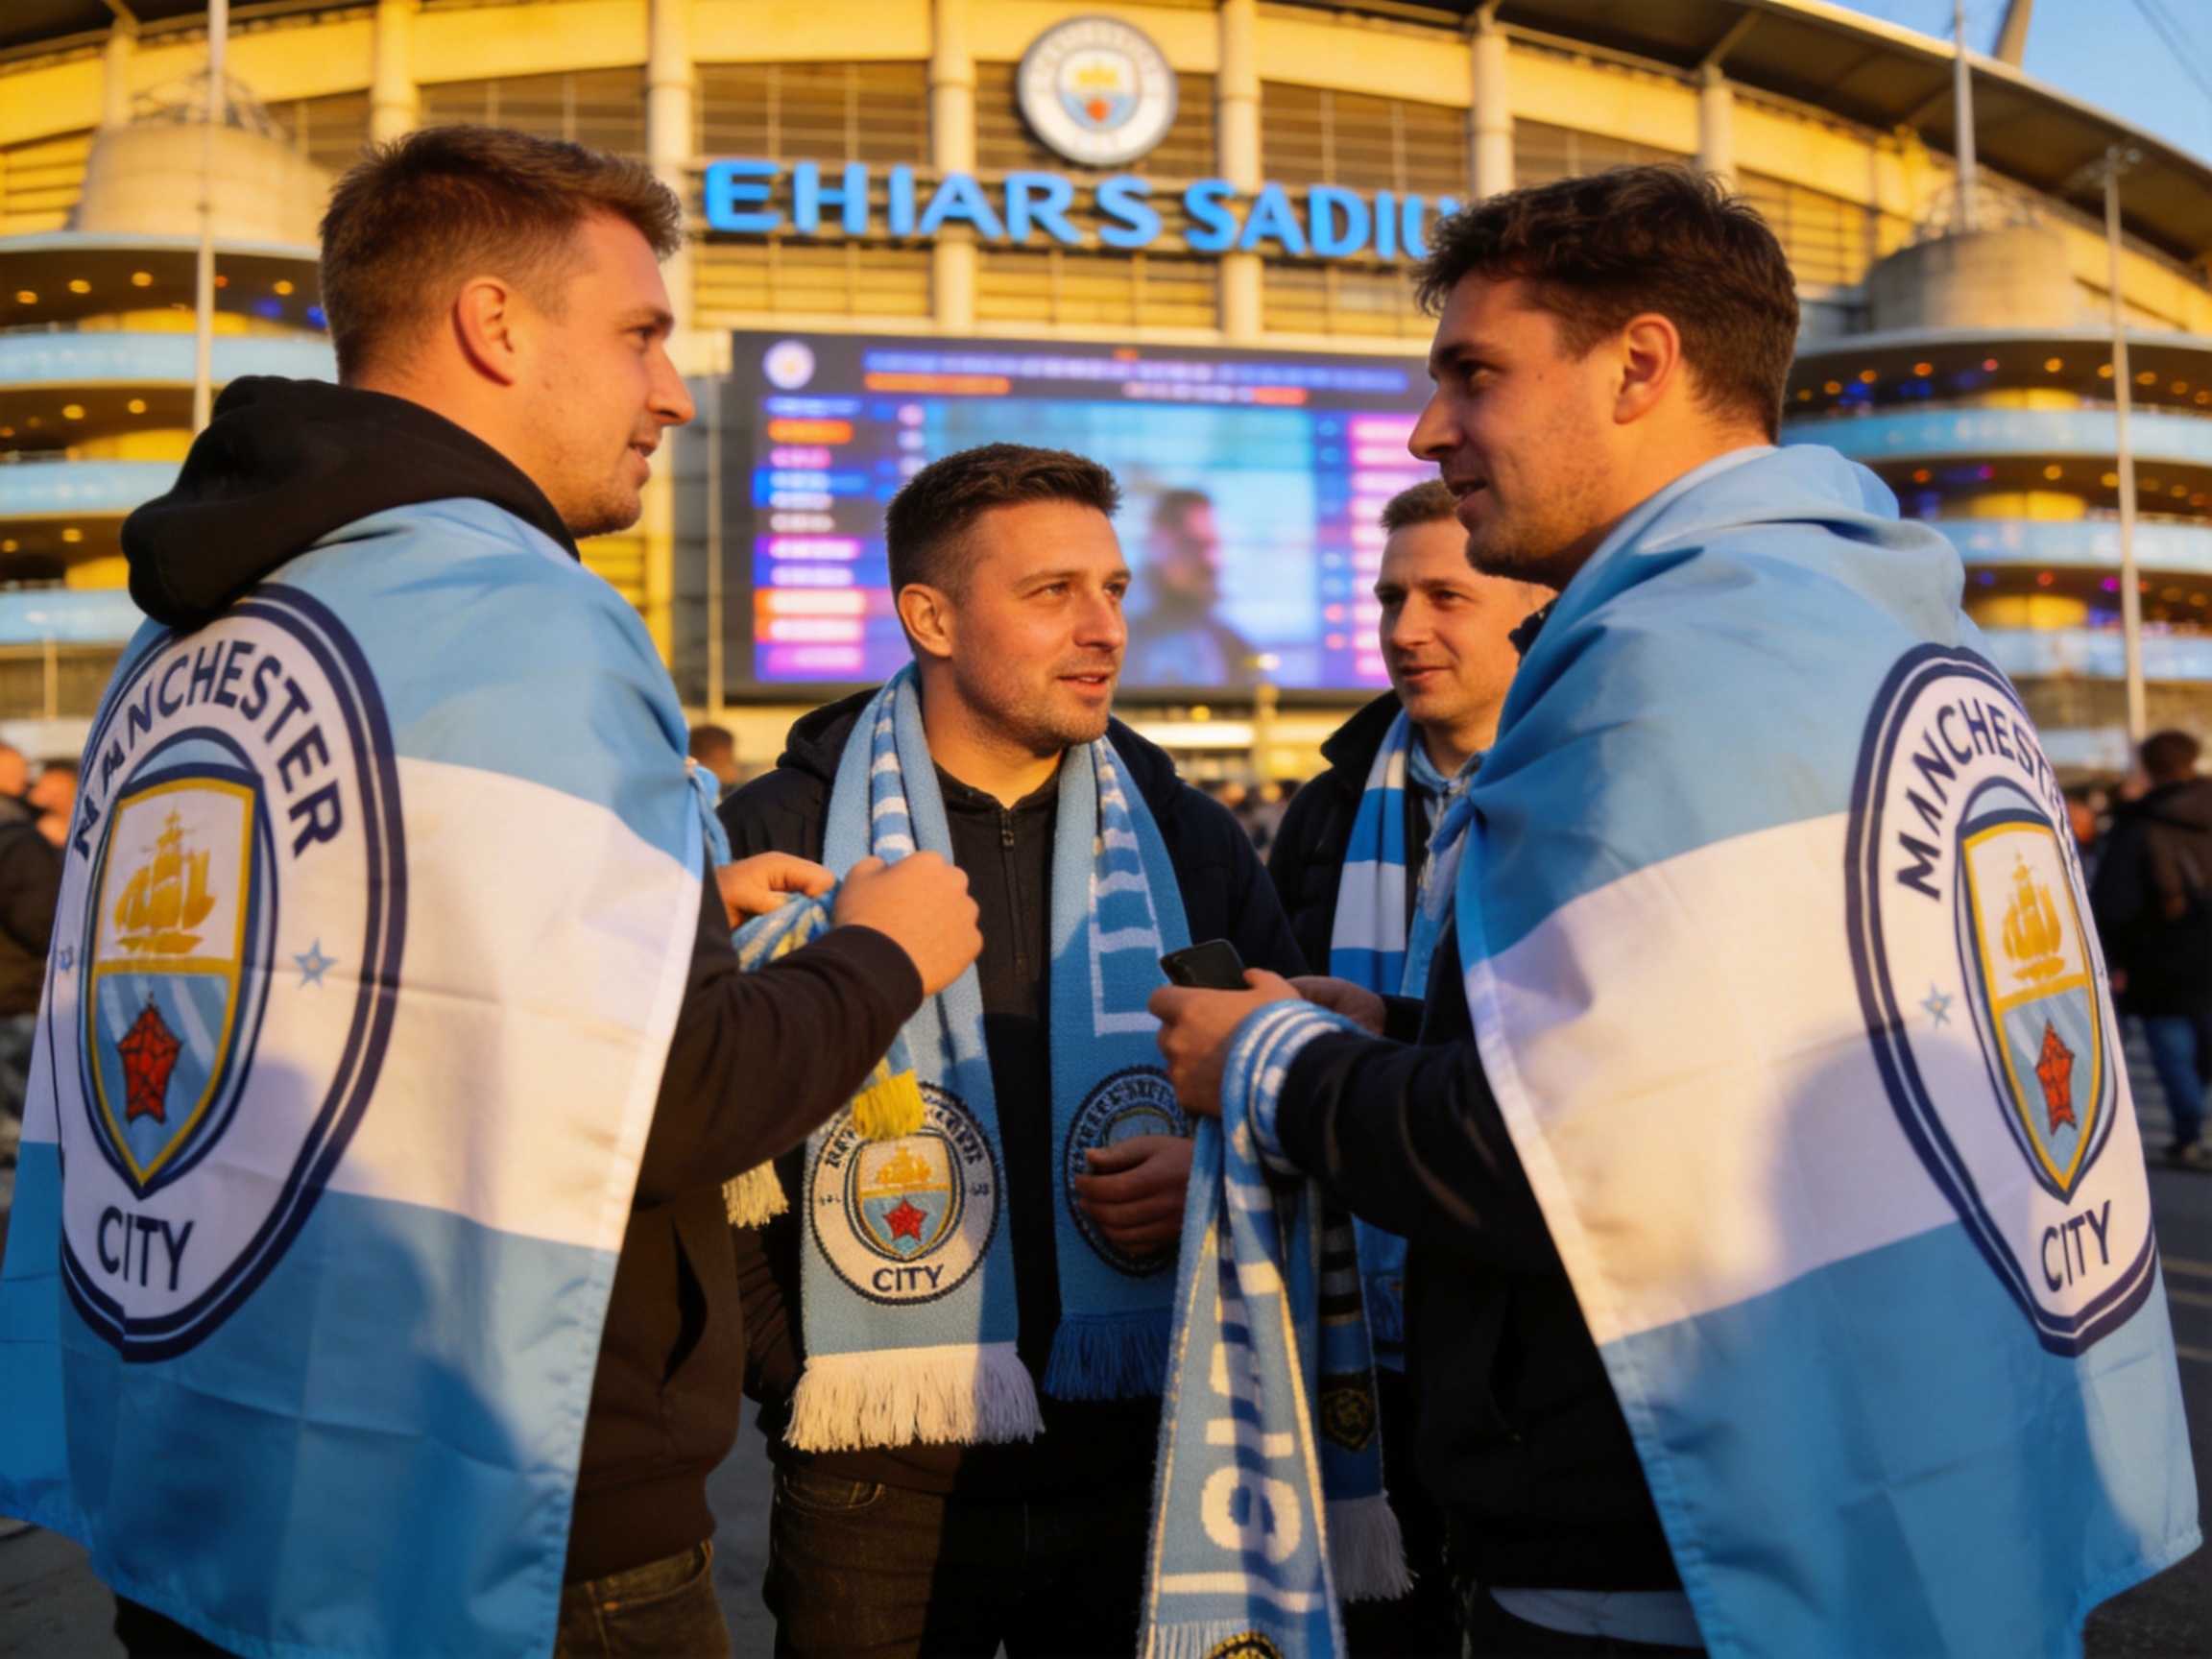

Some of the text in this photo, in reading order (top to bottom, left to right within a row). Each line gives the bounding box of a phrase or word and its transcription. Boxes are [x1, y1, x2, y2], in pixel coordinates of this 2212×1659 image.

[703, 159, 1164, 249] EHIARS
[98, 1205, 195, 1292] CITY
[872, 1263, 945, 1293] CITY
[2041, 1199, 2111, 1293] CITY
